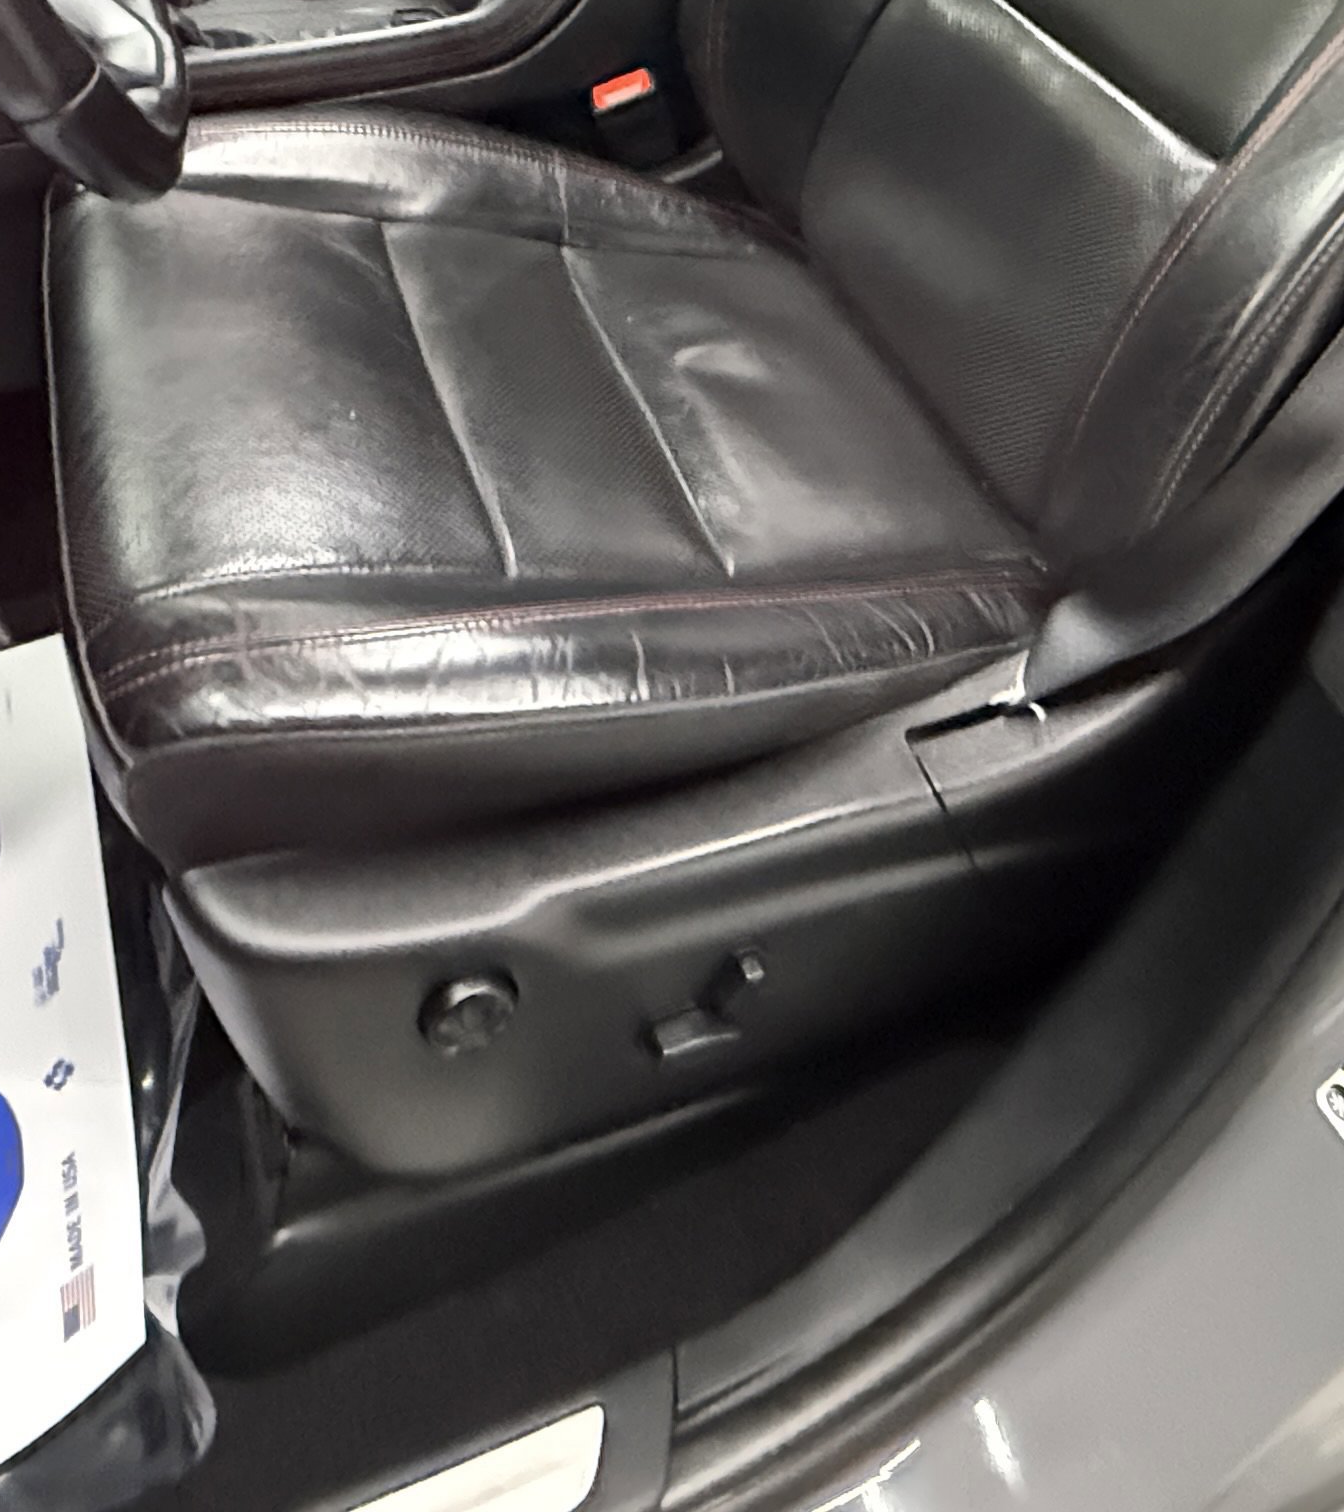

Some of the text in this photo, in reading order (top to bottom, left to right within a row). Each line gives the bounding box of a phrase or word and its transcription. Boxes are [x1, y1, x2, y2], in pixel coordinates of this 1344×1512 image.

[61, 1150, 83, 1271] MADE IN USA
